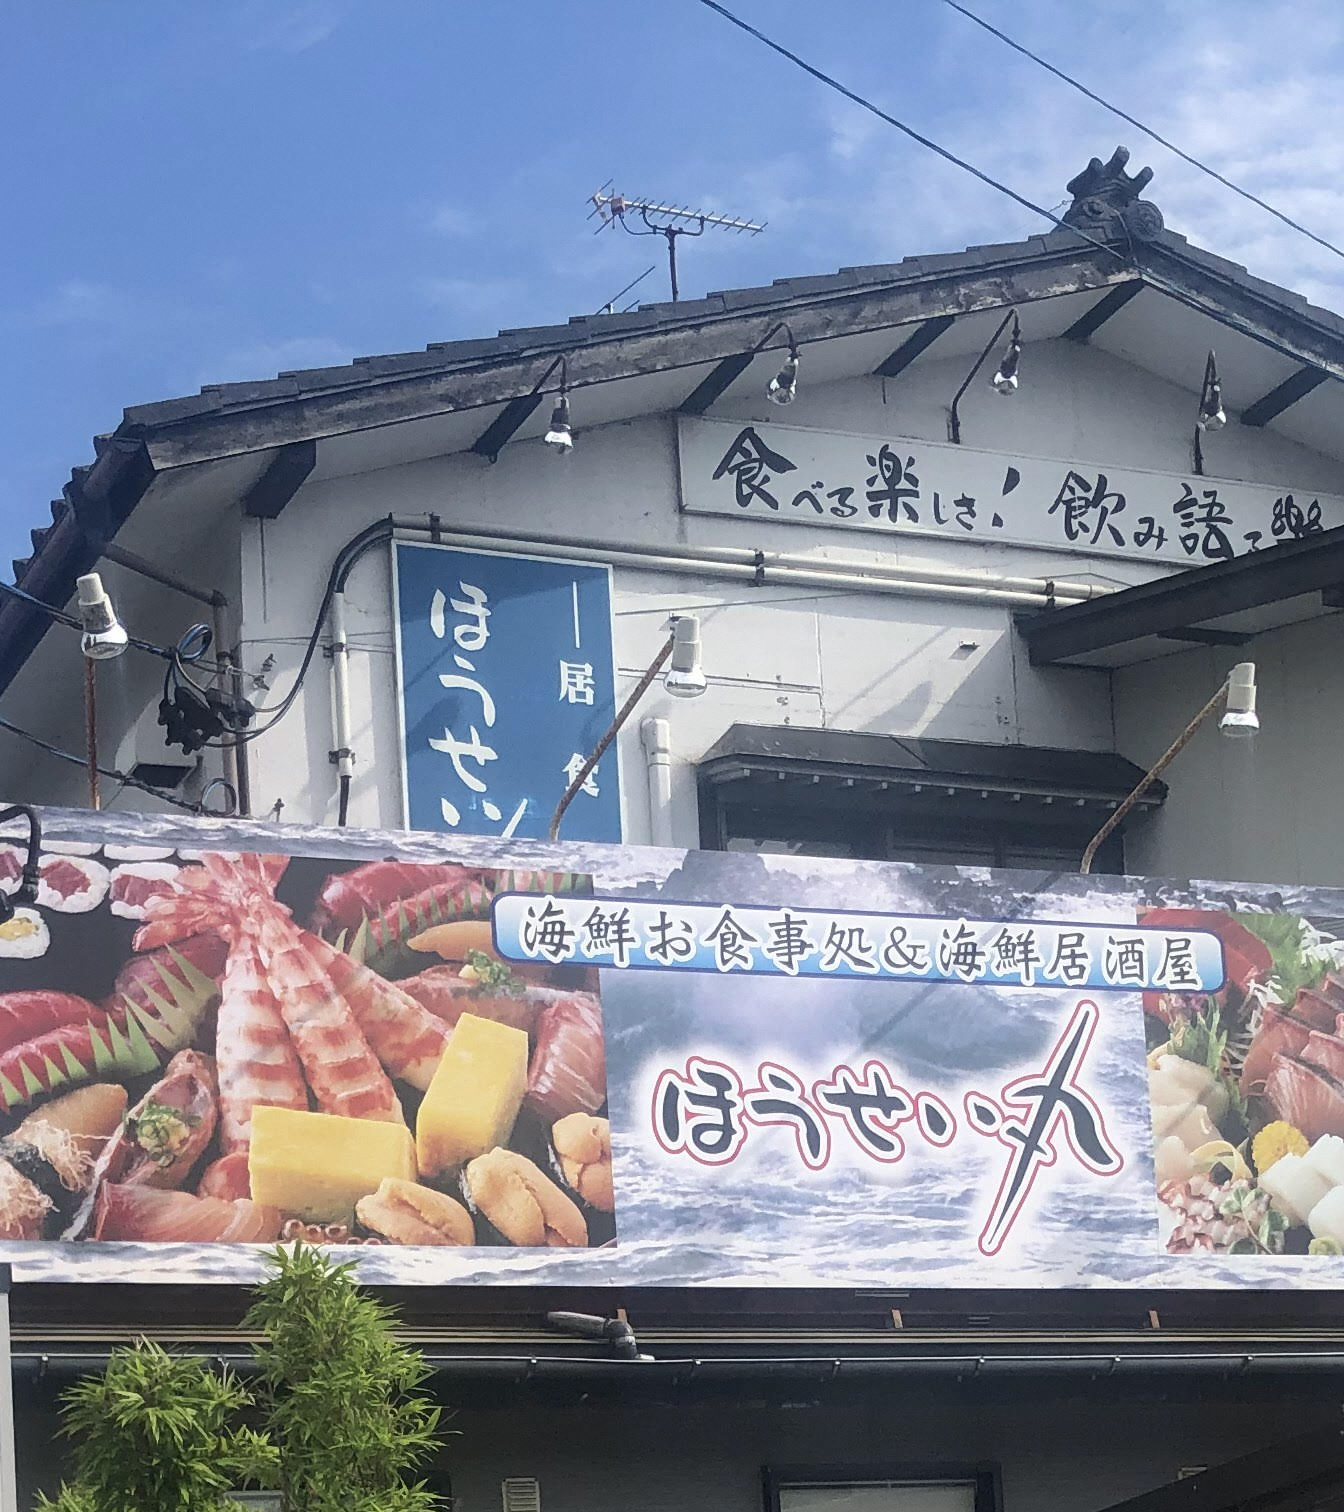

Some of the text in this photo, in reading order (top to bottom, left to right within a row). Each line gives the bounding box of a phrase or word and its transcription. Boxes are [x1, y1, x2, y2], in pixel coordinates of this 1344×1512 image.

[429, 581, 528, 838] ほうせい
[521, 899, 1204, 988] 海鮮お食事処&海鮮居酒屋
[657, 1003, 1119, 1252] ほうせい丸
